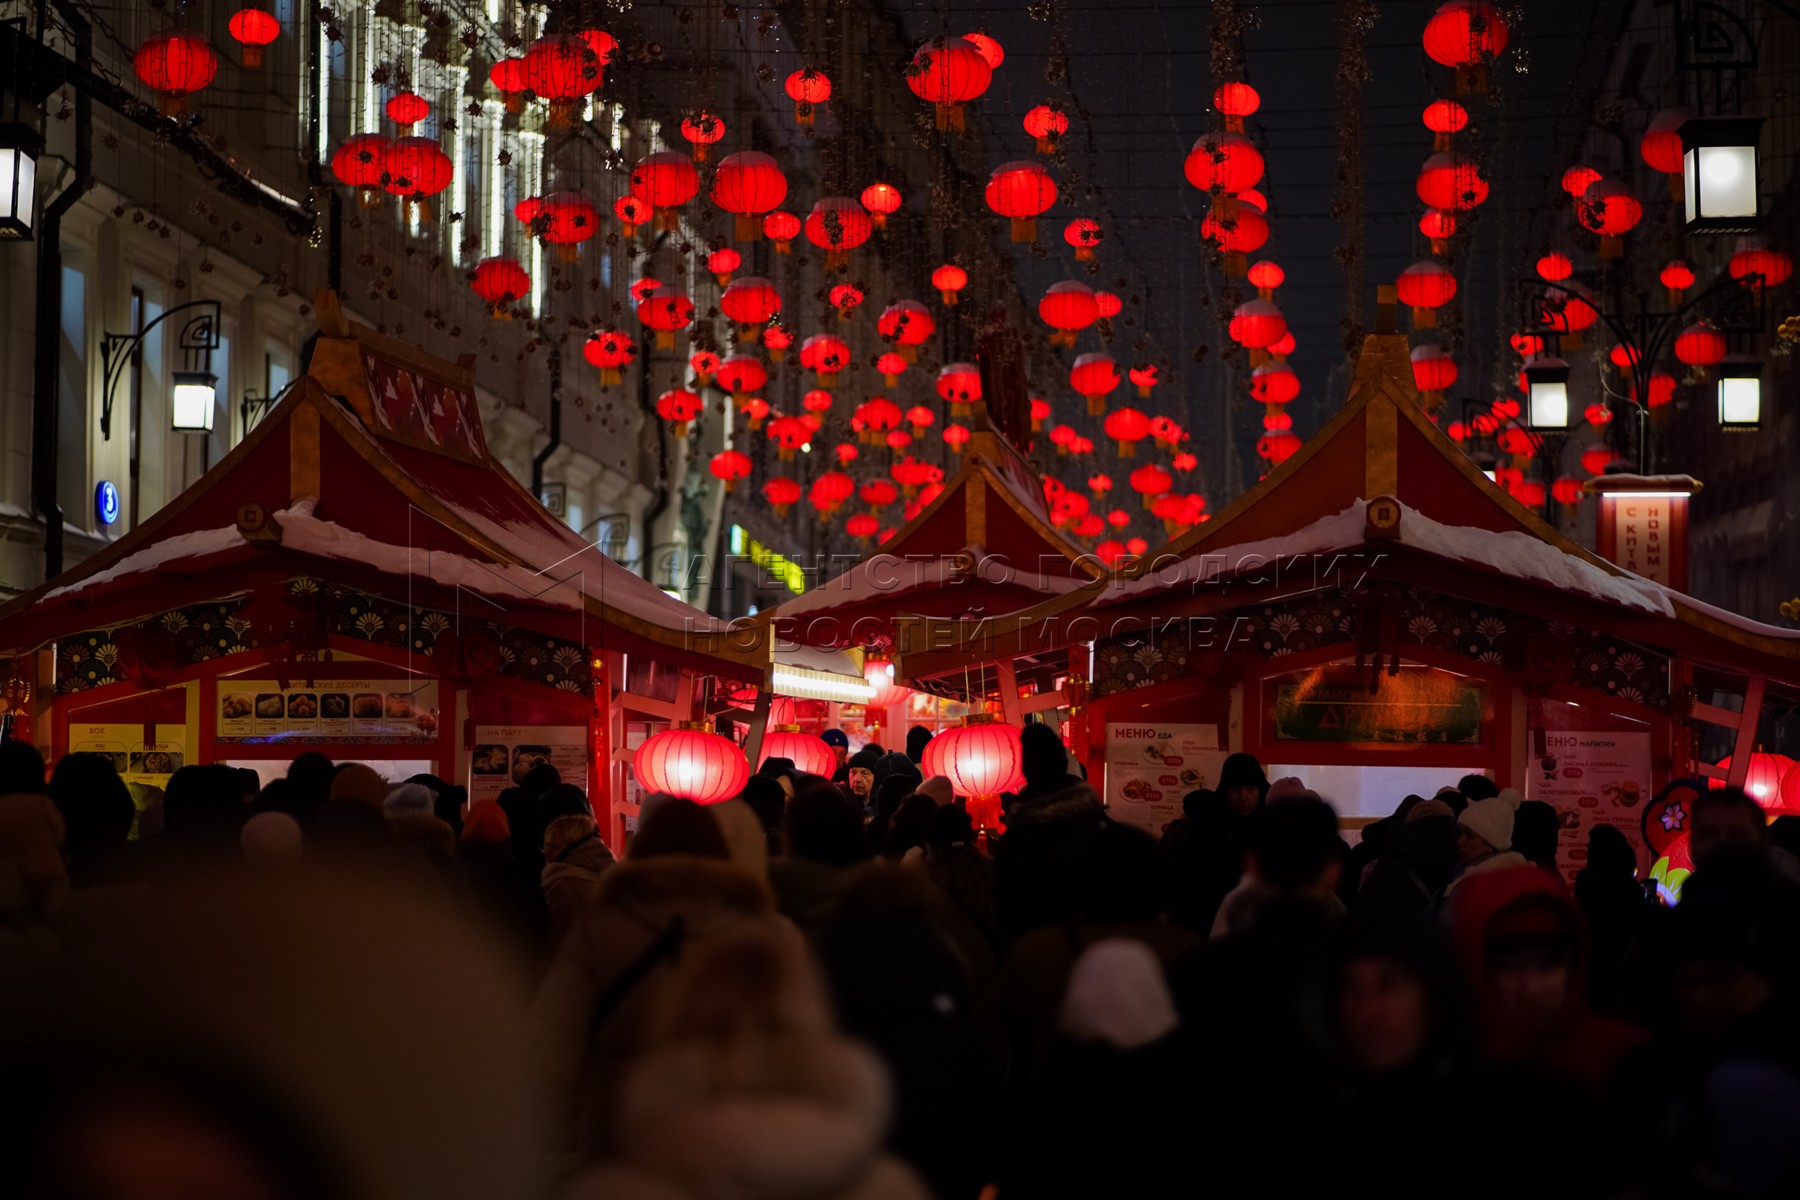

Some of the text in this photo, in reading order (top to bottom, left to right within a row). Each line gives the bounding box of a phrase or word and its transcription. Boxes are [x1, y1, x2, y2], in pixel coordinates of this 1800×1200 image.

[1626, 507, 1637, 569] С КИТА
[1646, 507, 1660, 566] НОВЫМ
[335, 681, 371, 690] ДЕСЕРТЫ
[89, 727, 106, 735] ВОК
[1115, 728, 1156, 739] МЕНЮ
[1546, 737, 1616, 748] ЕНЮ НАПИТКИ
